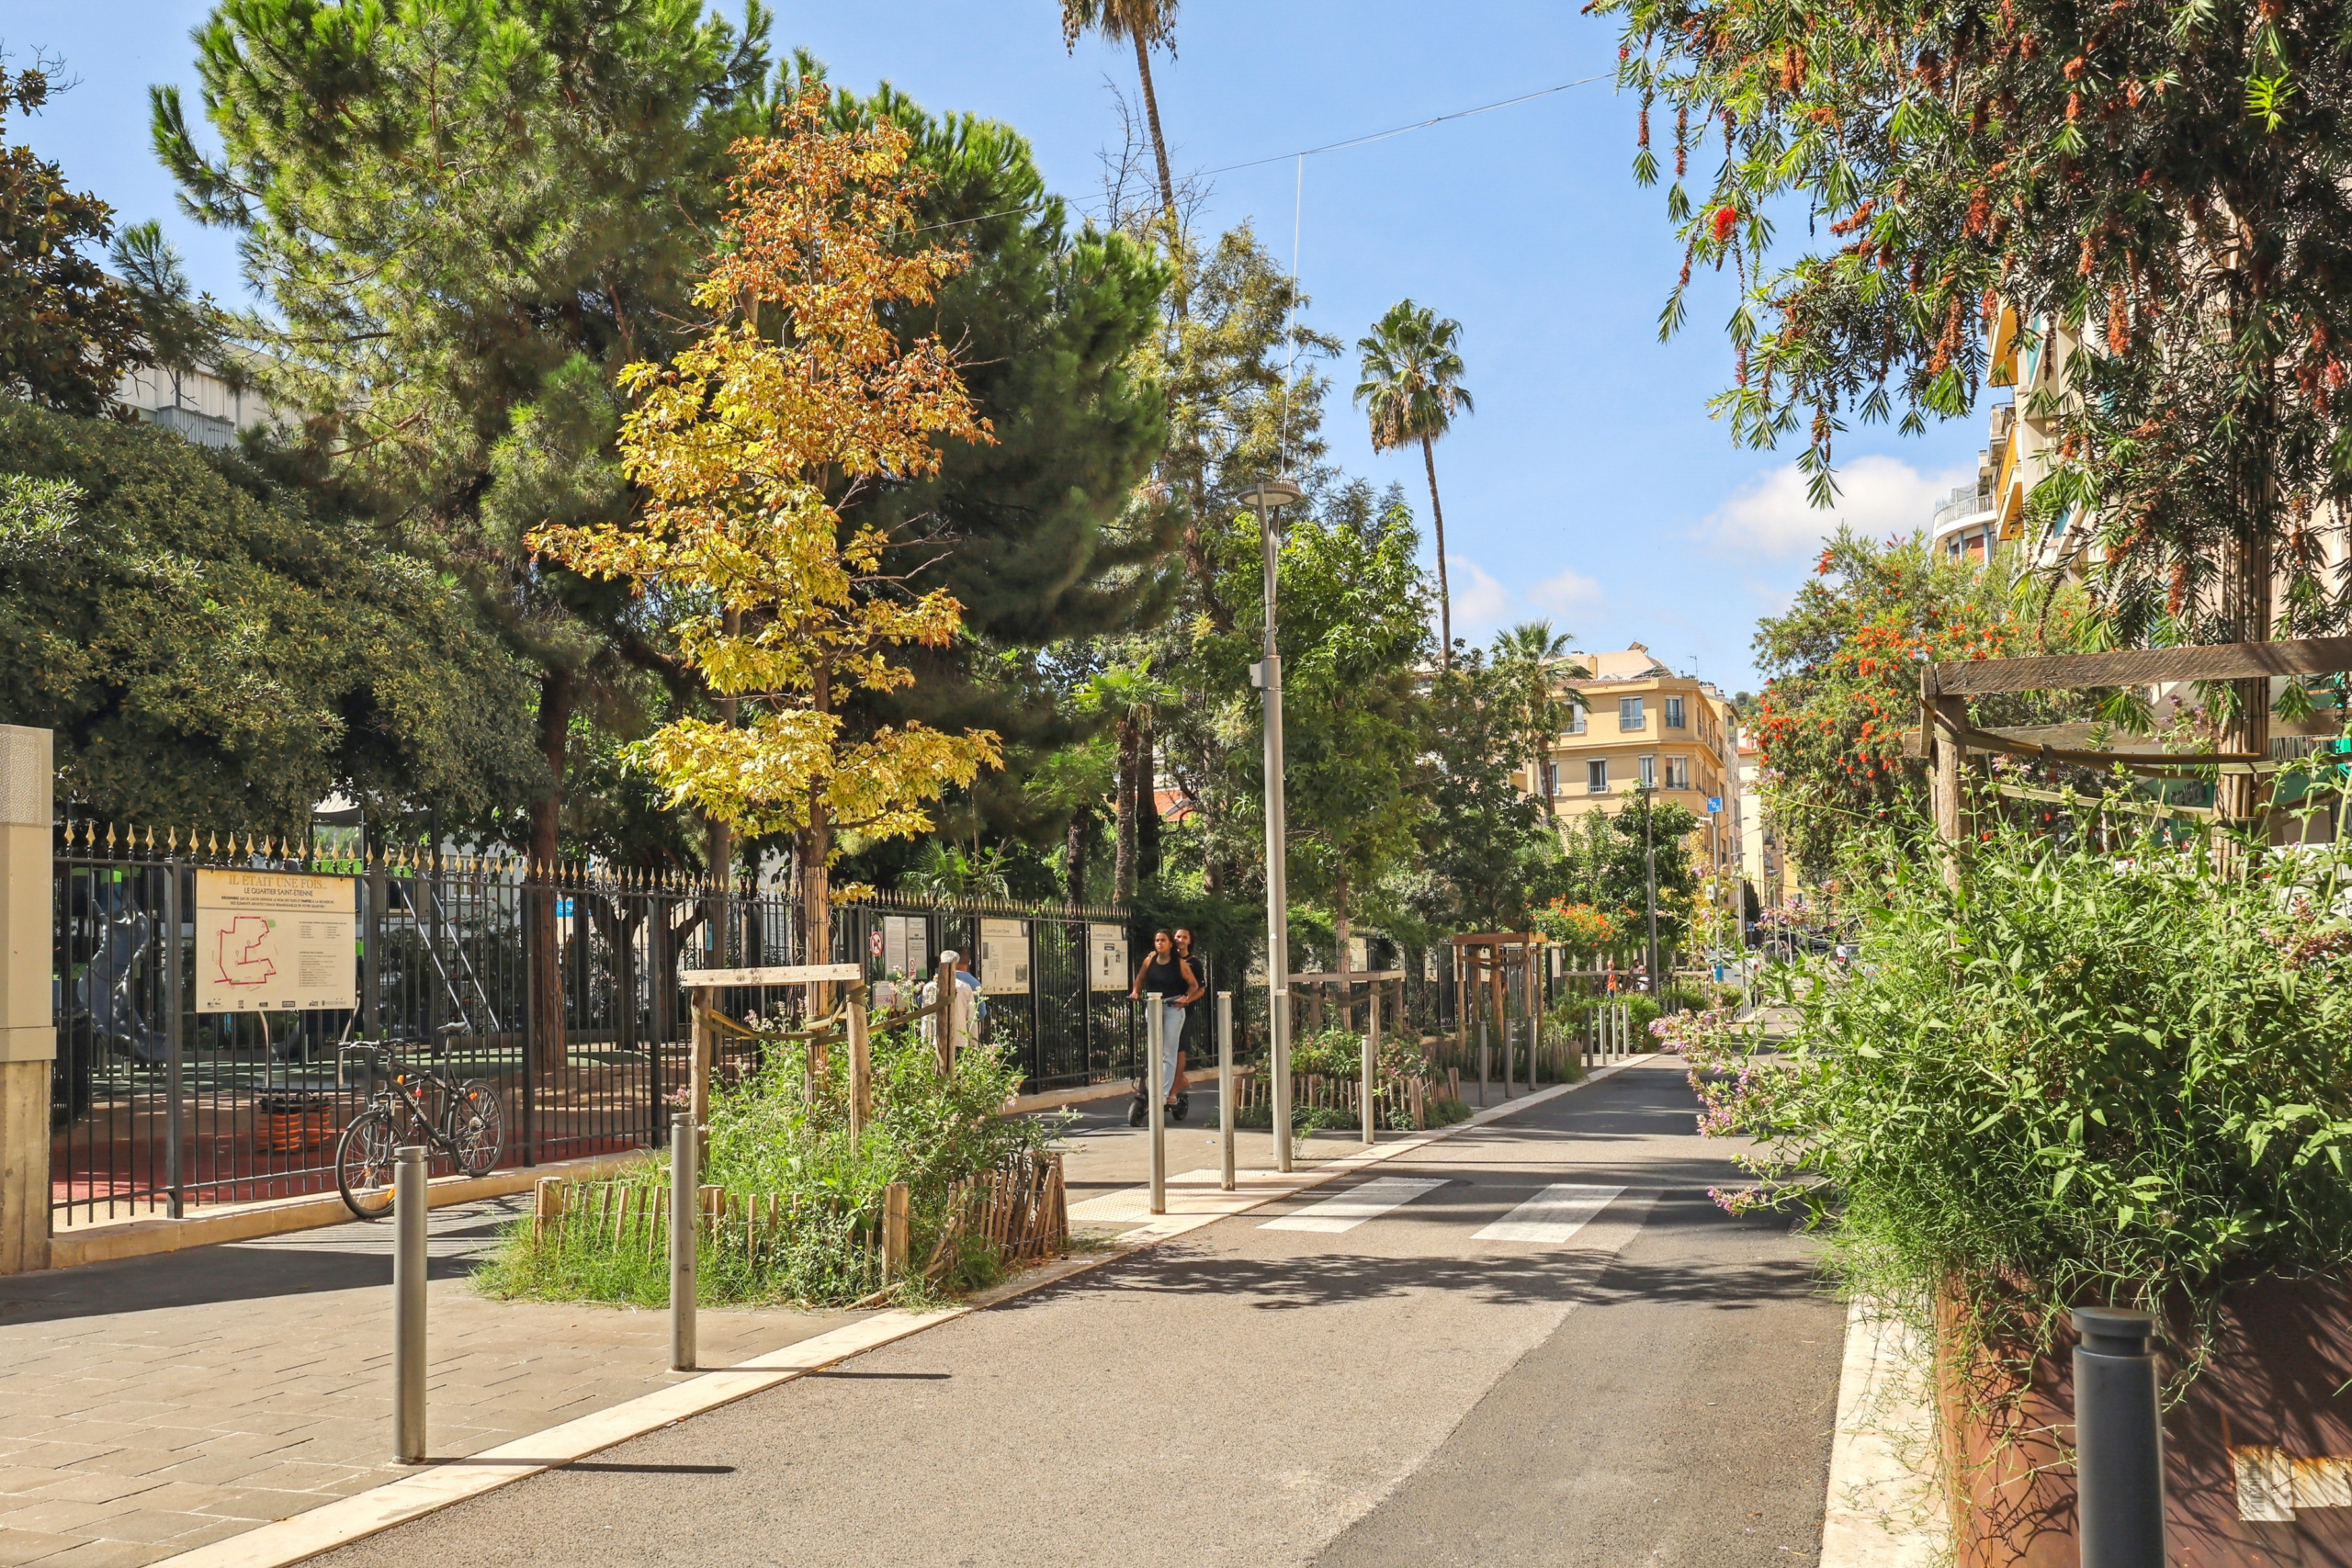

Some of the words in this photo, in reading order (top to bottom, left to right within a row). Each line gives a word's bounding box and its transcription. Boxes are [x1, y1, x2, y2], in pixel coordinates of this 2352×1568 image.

[1708, 798, 1720, 812] SOS
[229, 874, 239, 885] IL
[242, 873, 273, 886] ÉTAIT
[276, 877, 298, 888] UNE
[300, 878, 327, 890] FOIS...
